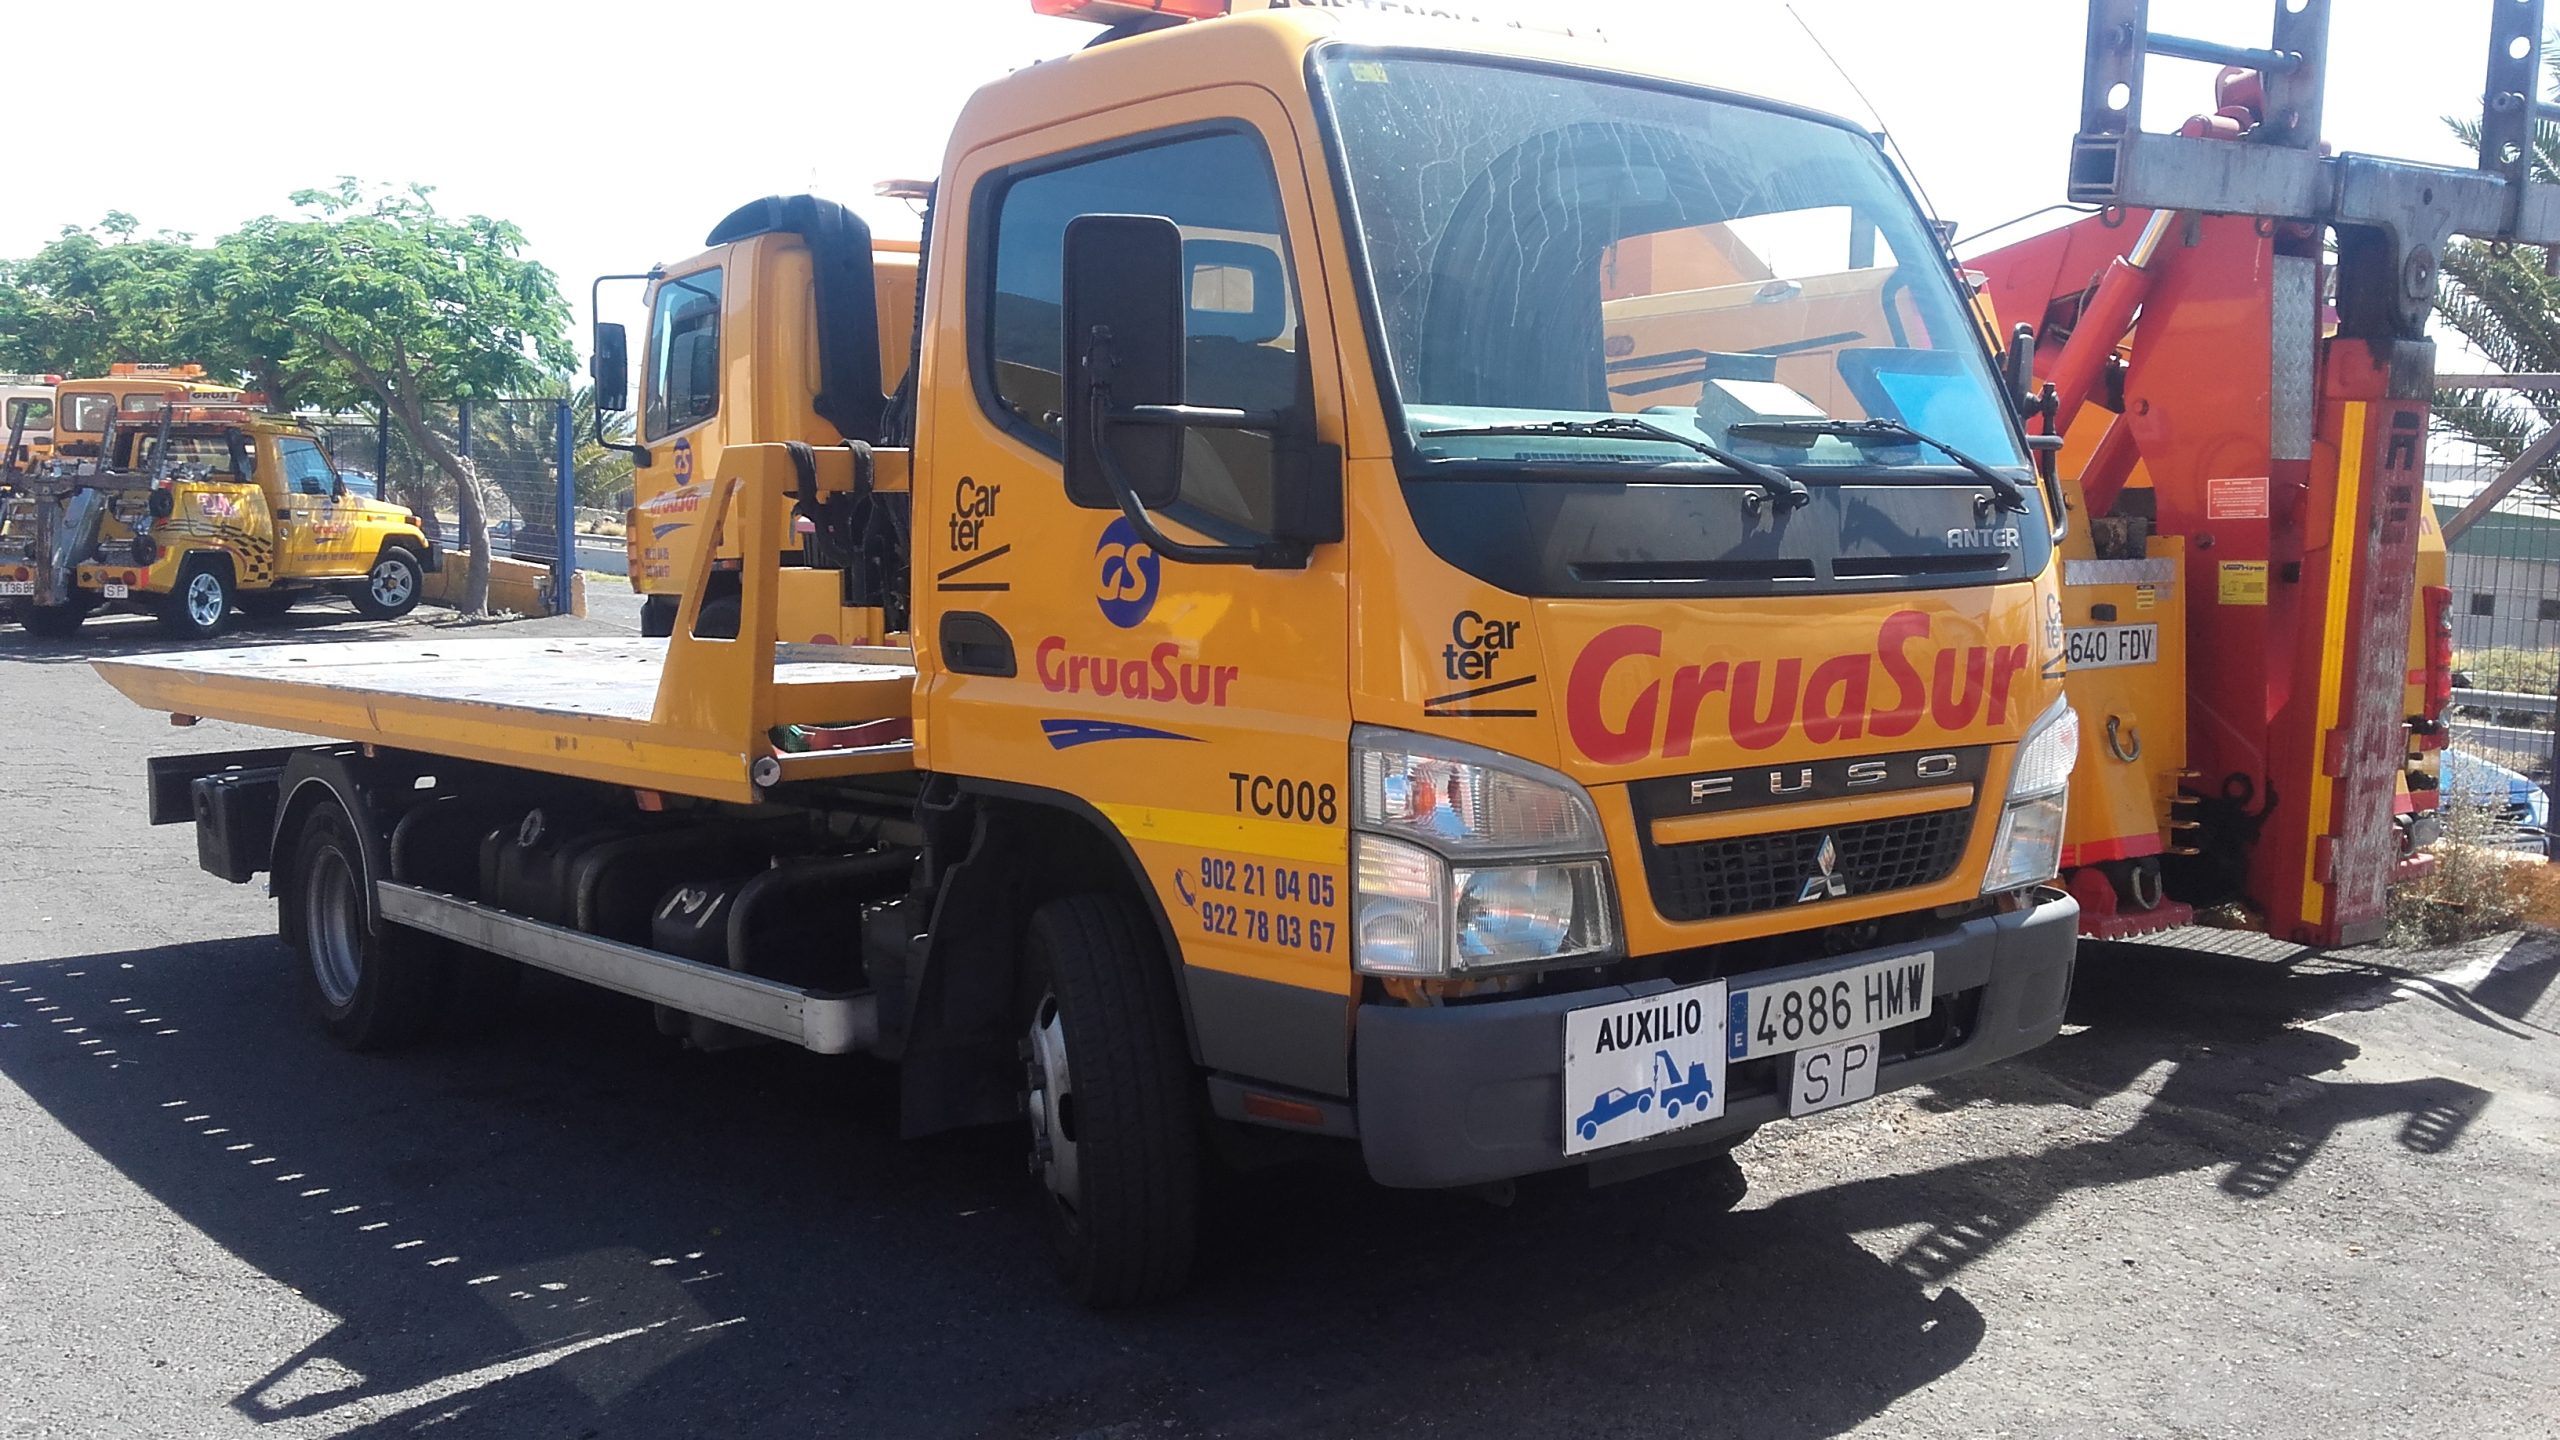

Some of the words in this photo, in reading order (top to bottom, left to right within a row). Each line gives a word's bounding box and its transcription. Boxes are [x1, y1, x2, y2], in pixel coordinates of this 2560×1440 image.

[956, 476, 1000, 518] Car
[949, 513, 984, 551] ter
[1947, 527, 2019, 548] ANTER
[106, 586, 126, 597] SP
[1453, 610, 1520, 649] Car
[2119, 629, 2152, 661] FDV
[1036, 635, 1239, 707] GruaSur
[1442, 644, 1499, 680] ter
[1567, 610, 2028, 765] GruaSur
[1229, 772, 1337, 824] TC008
[1690, 753, 1958, 804] FUSO
[1201, 857, 1236, 891] 902
[1244, 863, 1265, 896] 21
[1275, 868, 1300, 902] 04
[1308, 873, 1334, 907] 05
[1203, 901, 1237, 936] 922
[1245, 909, 1269, 942] 78
[1277, 914, 1301, 948] 03
[1310, 919, 1335, 953] 67
[1596, 999, 1701, 1054] AUXILIO
[1757, 981, 1851, 1046] 4886
[1865, 963, 1925, 1024] HMW
[1734, 1032, 1743, 1047] E
